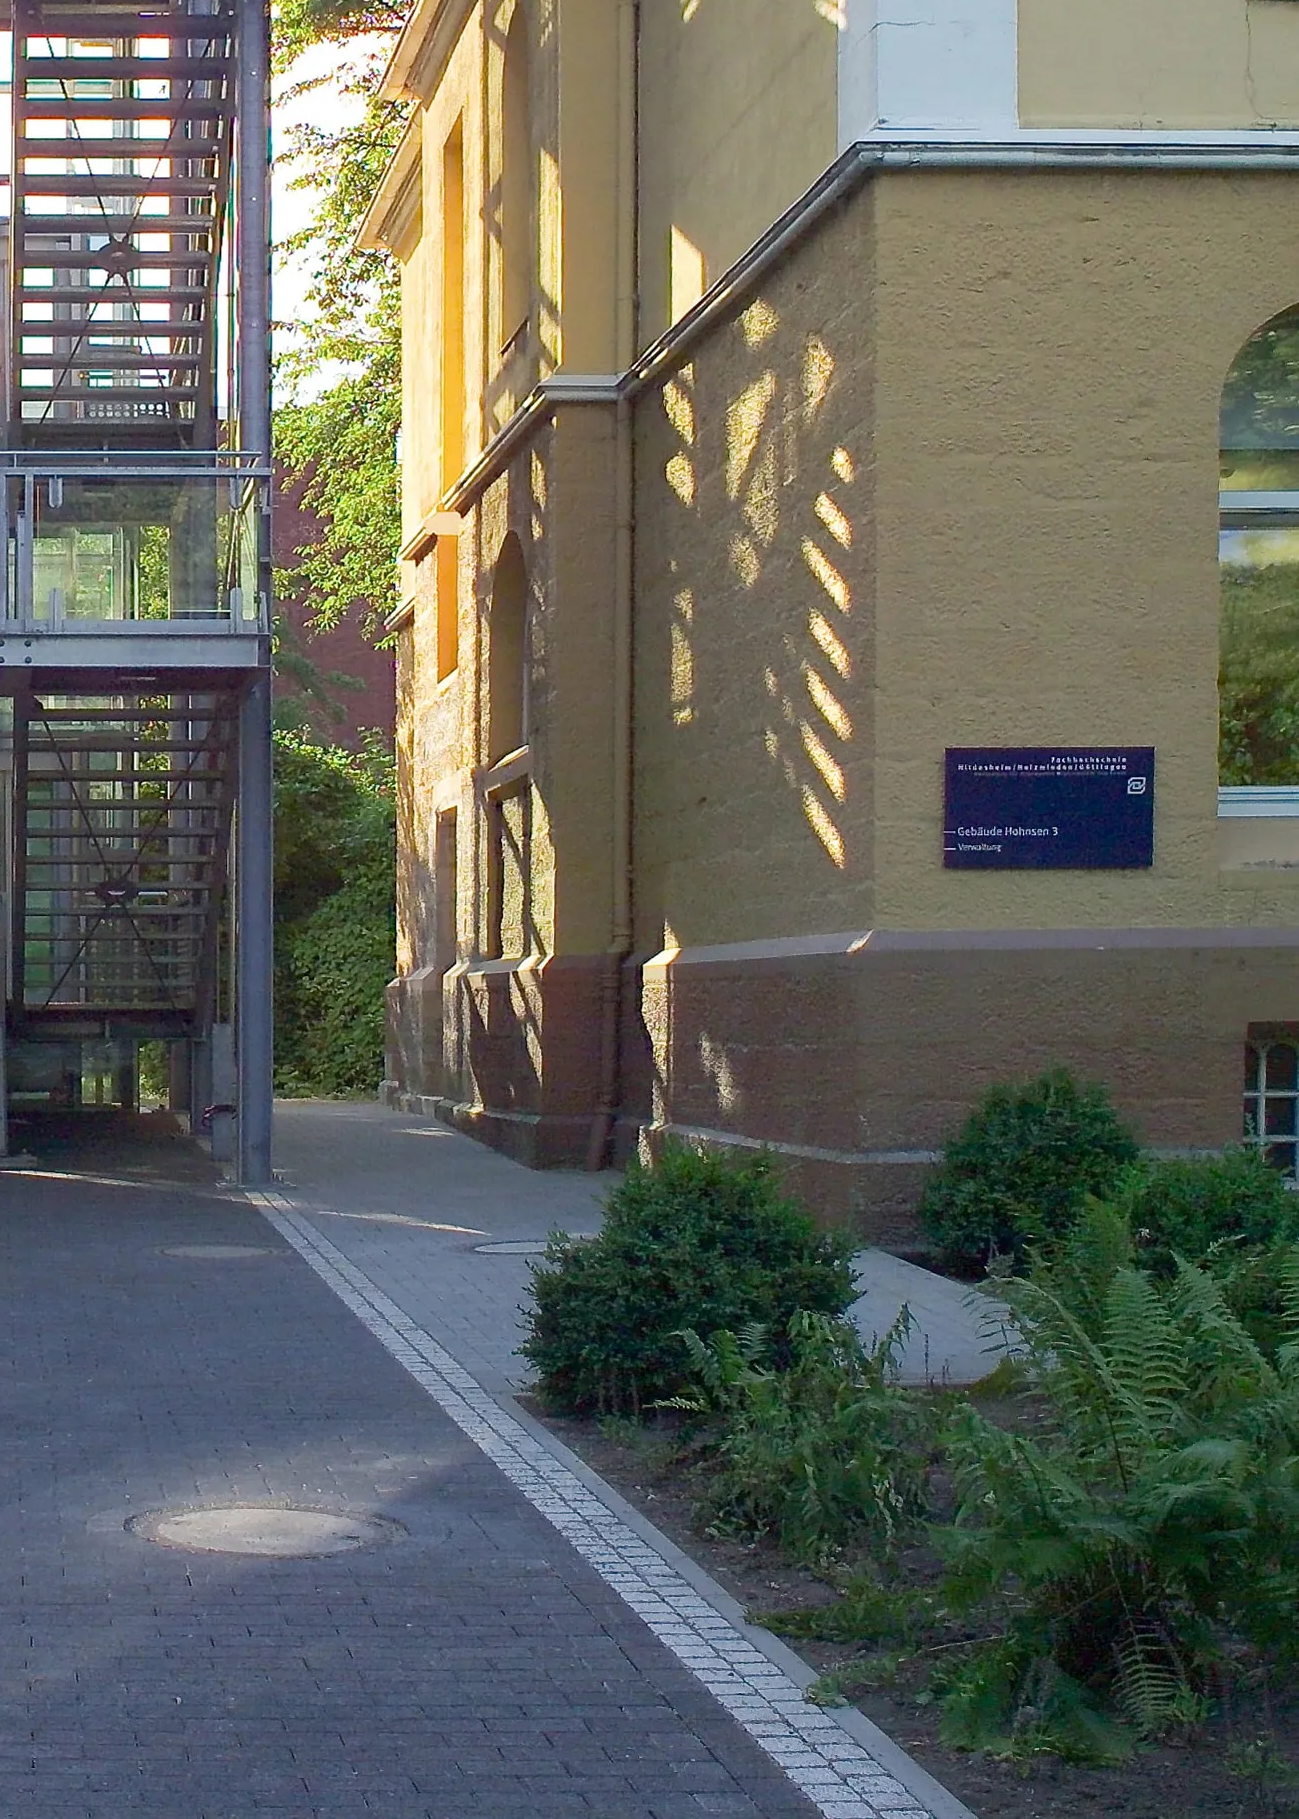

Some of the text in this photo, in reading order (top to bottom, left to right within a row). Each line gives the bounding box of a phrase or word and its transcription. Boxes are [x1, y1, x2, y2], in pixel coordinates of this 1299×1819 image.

[957, 825, 1059, 836] Gebäude Hohnsen 3
[957, 843, 1002, 852] Verwaltung
